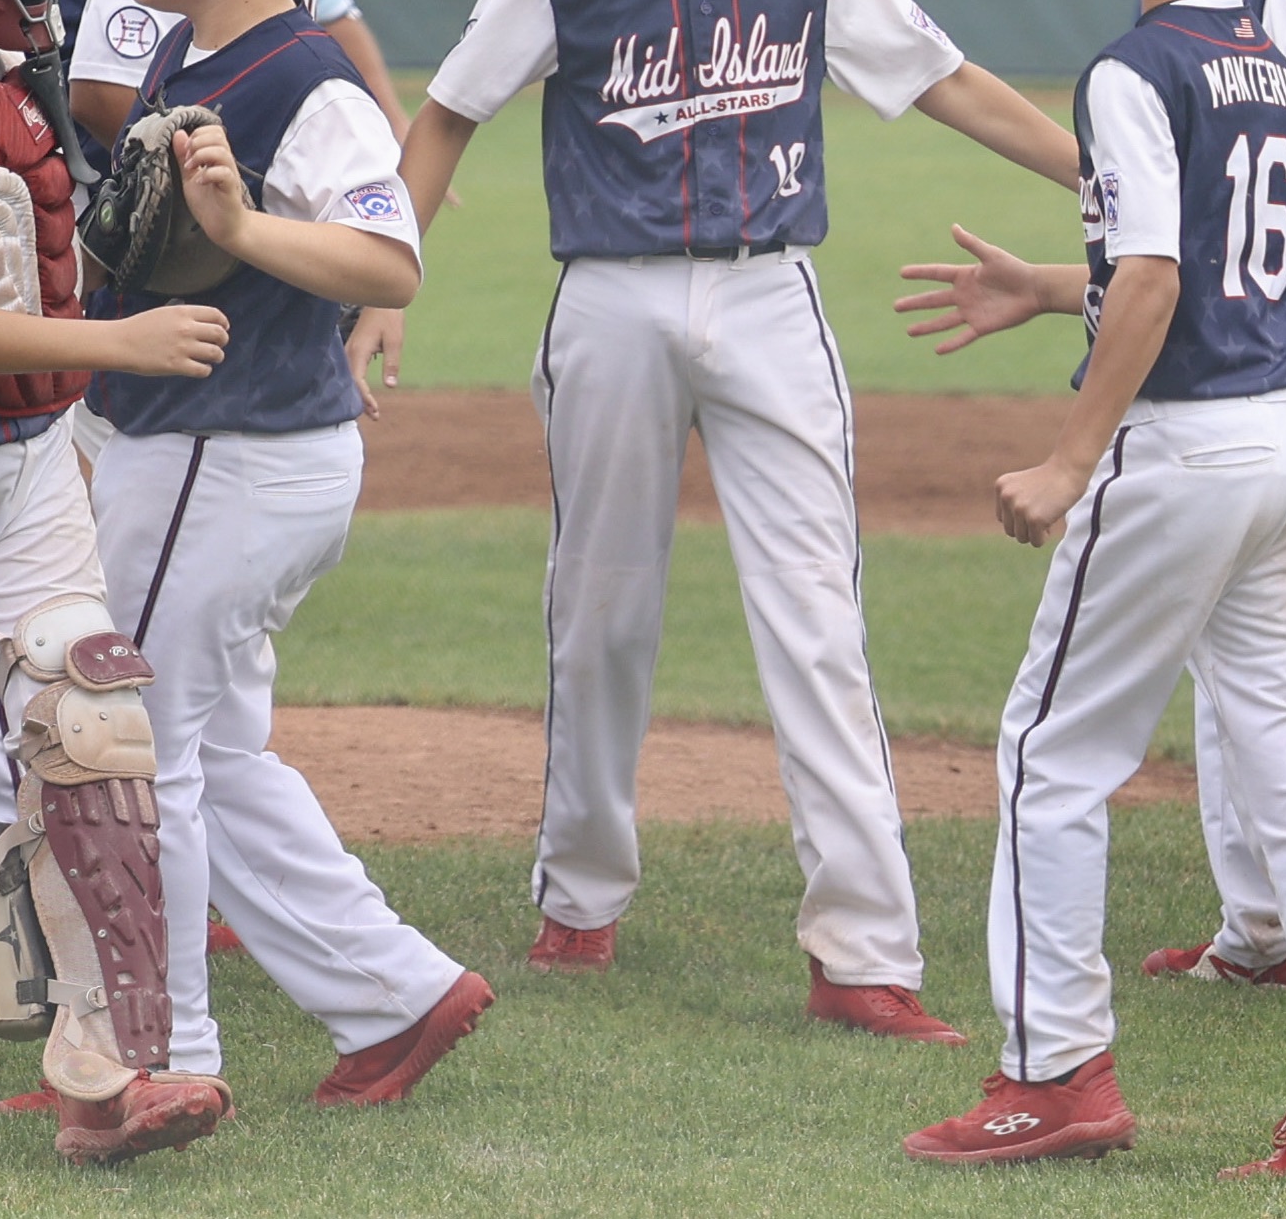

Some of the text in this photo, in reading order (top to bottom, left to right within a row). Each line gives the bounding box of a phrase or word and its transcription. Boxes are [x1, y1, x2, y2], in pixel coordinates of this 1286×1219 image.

[598, 11, 812, 104] Mid Island
[675, 93, 770, 121] ALL-STARS
